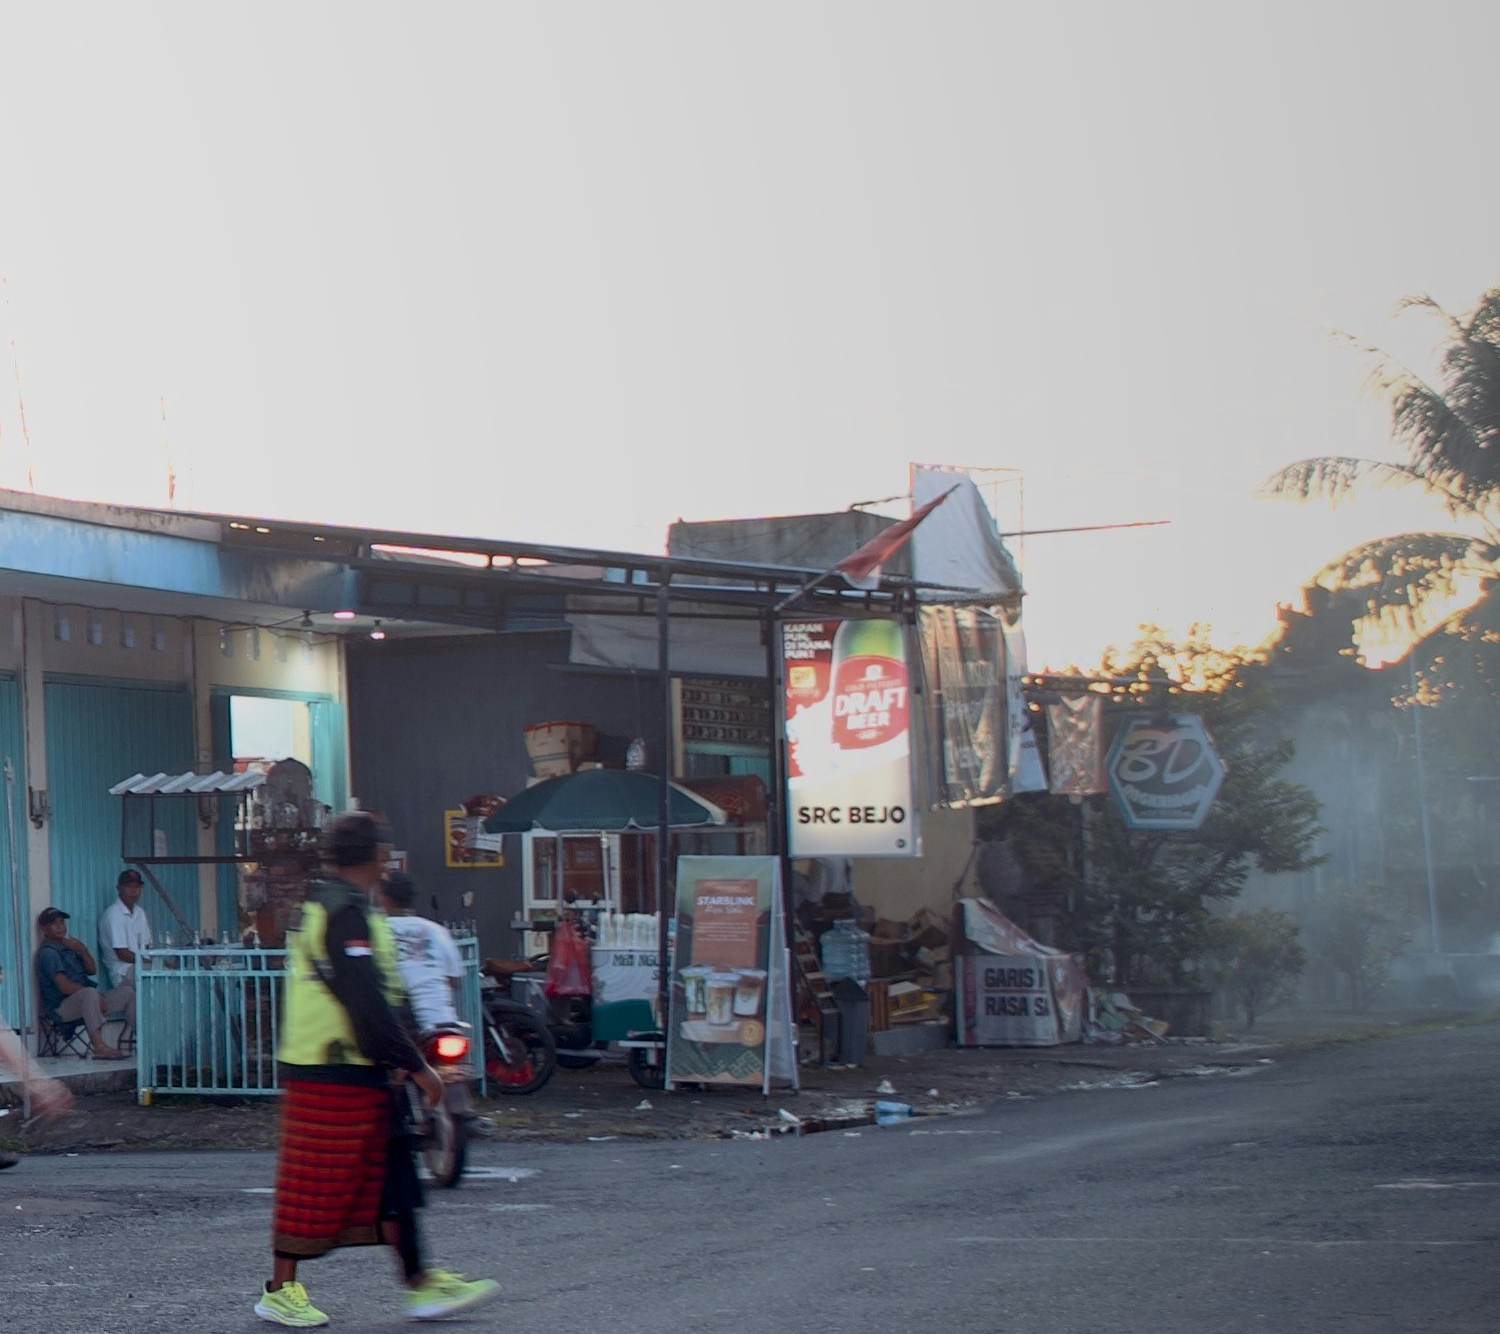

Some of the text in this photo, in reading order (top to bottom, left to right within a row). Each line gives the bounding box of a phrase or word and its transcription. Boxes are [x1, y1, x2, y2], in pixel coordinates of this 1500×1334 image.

[835, 686, 905, 717] DRAFT
[846, 712, 890, 730] BEER
[798, 806, 905, 824] SRC BEJO
[985, 968, 1034, 988] GARIS
[985, 996, 1029, 1017] RASA
